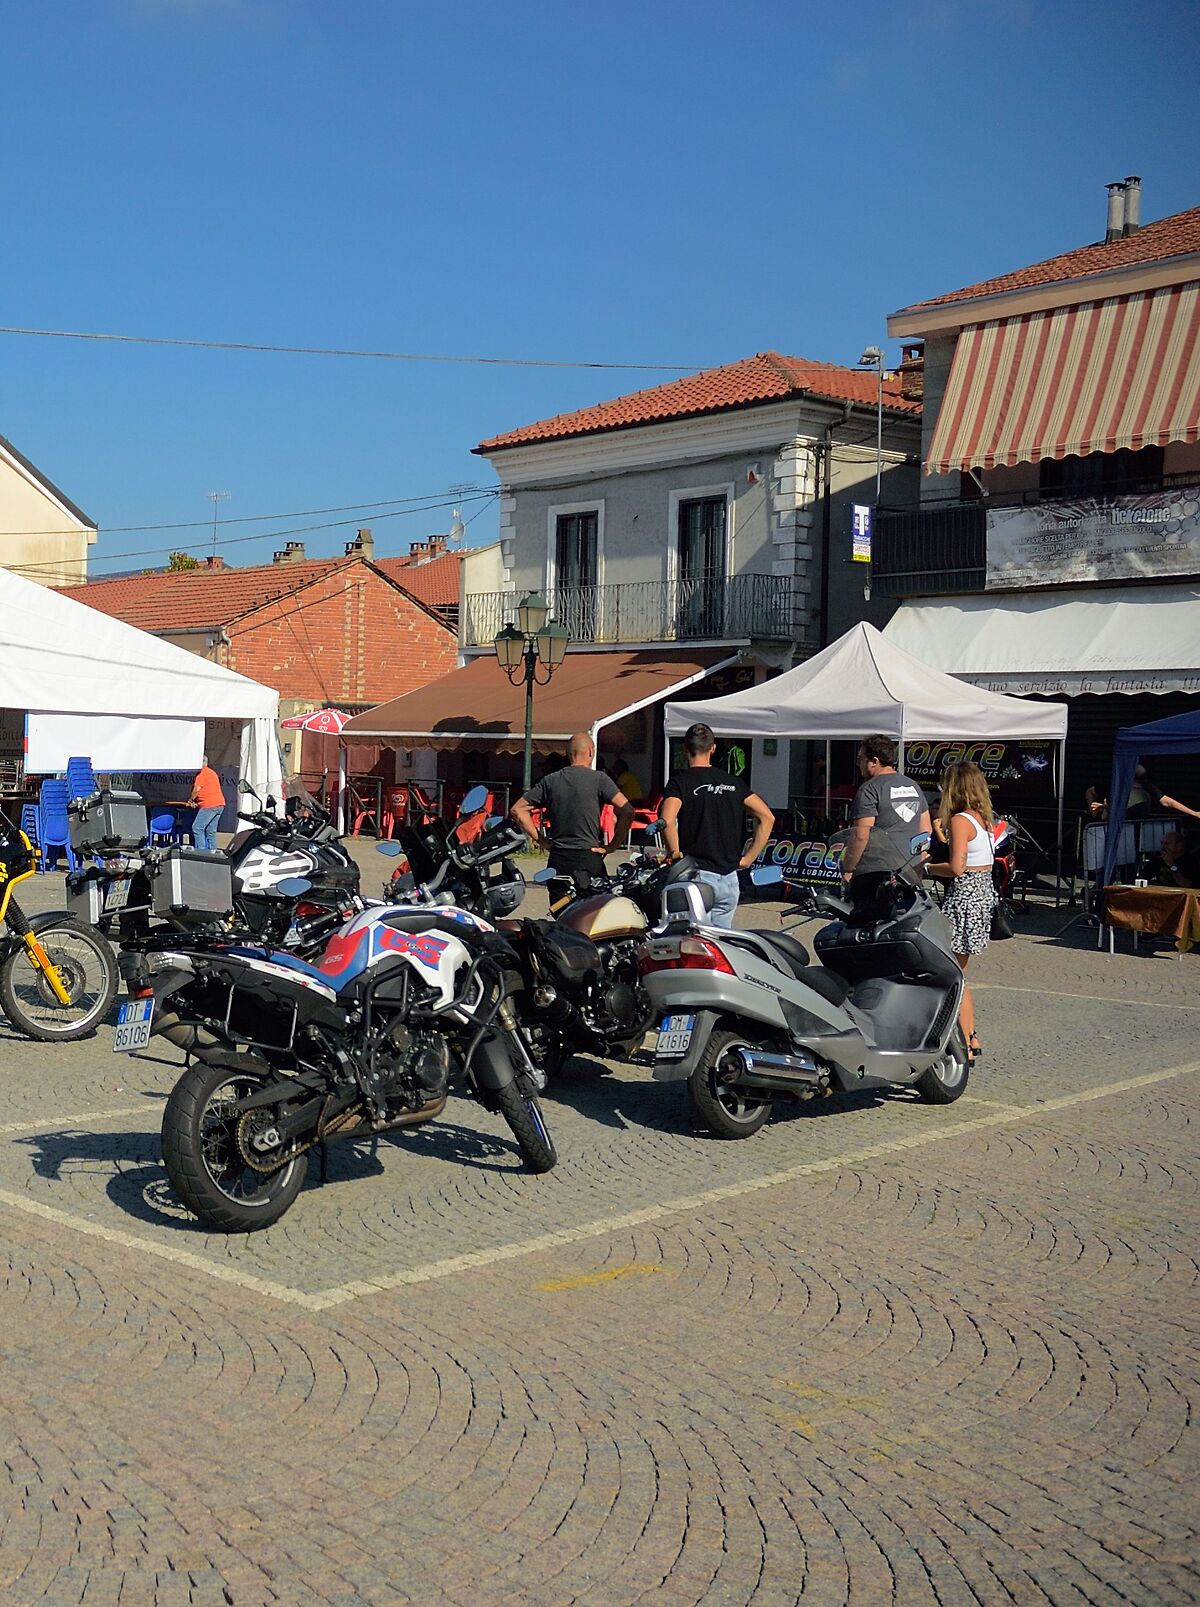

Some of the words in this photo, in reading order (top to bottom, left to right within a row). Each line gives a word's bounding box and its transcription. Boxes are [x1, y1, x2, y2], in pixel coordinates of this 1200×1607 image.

[1111, 508, 1171, 525] ticketone
[988, 680, 1008, 692] tuo
[1017, 679, 1068, 692] servizio
[1080, 677, 1093, 692] la
[1105, 676, 1164, 693] fantasia
[380, 928, 450, 964] GS
[325, 954, 343, 964] GS
[127, 1003, 140, 1022] DT
[116, 1025, 147, 1046] 86106
